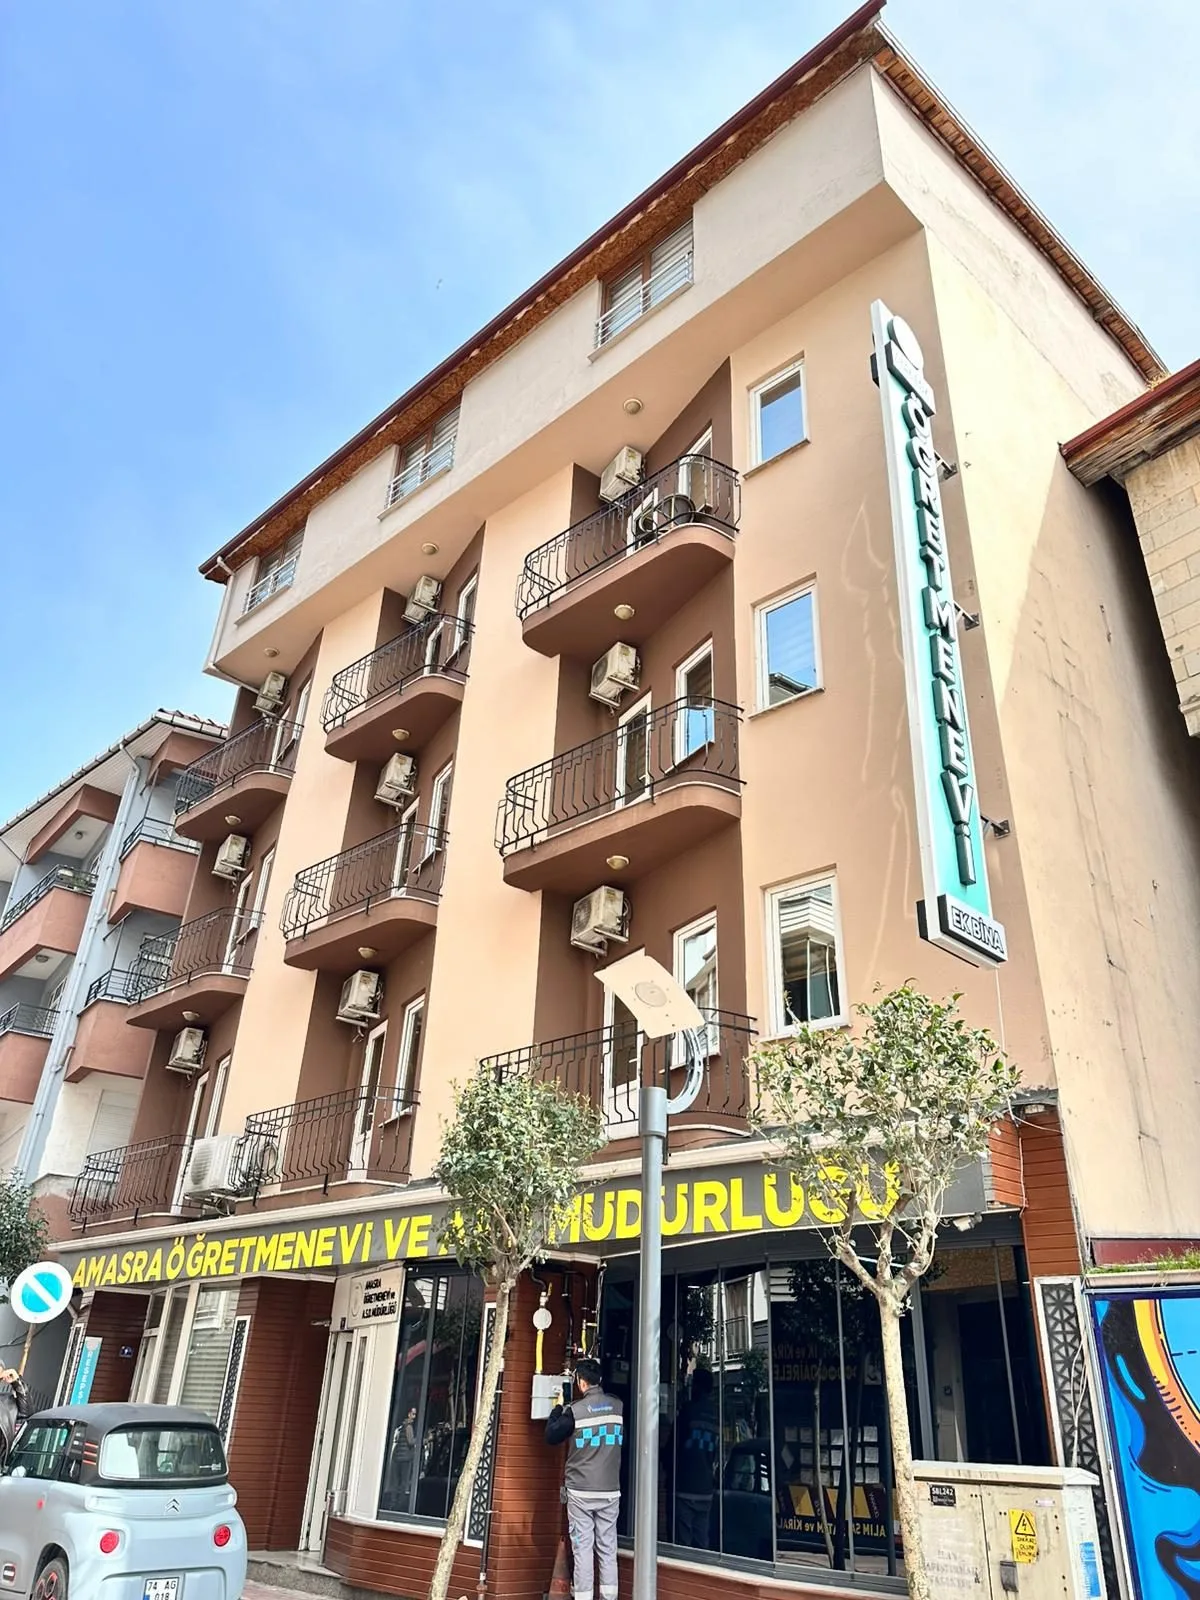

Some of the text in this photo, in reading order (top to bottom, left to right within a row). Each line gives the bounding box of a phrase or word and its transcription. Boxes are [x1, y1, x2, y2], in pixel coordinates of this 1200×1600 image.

[951, 905, 1005, 954] EK BİNA
[72, 1247, 162, 1289] AMASRA
[166, 1222, 374, 1281] ÖĞRETMENEVİ
[384, 1214, 433, 1260] VE
[147, 1580, 177, 1591] 74 AG
